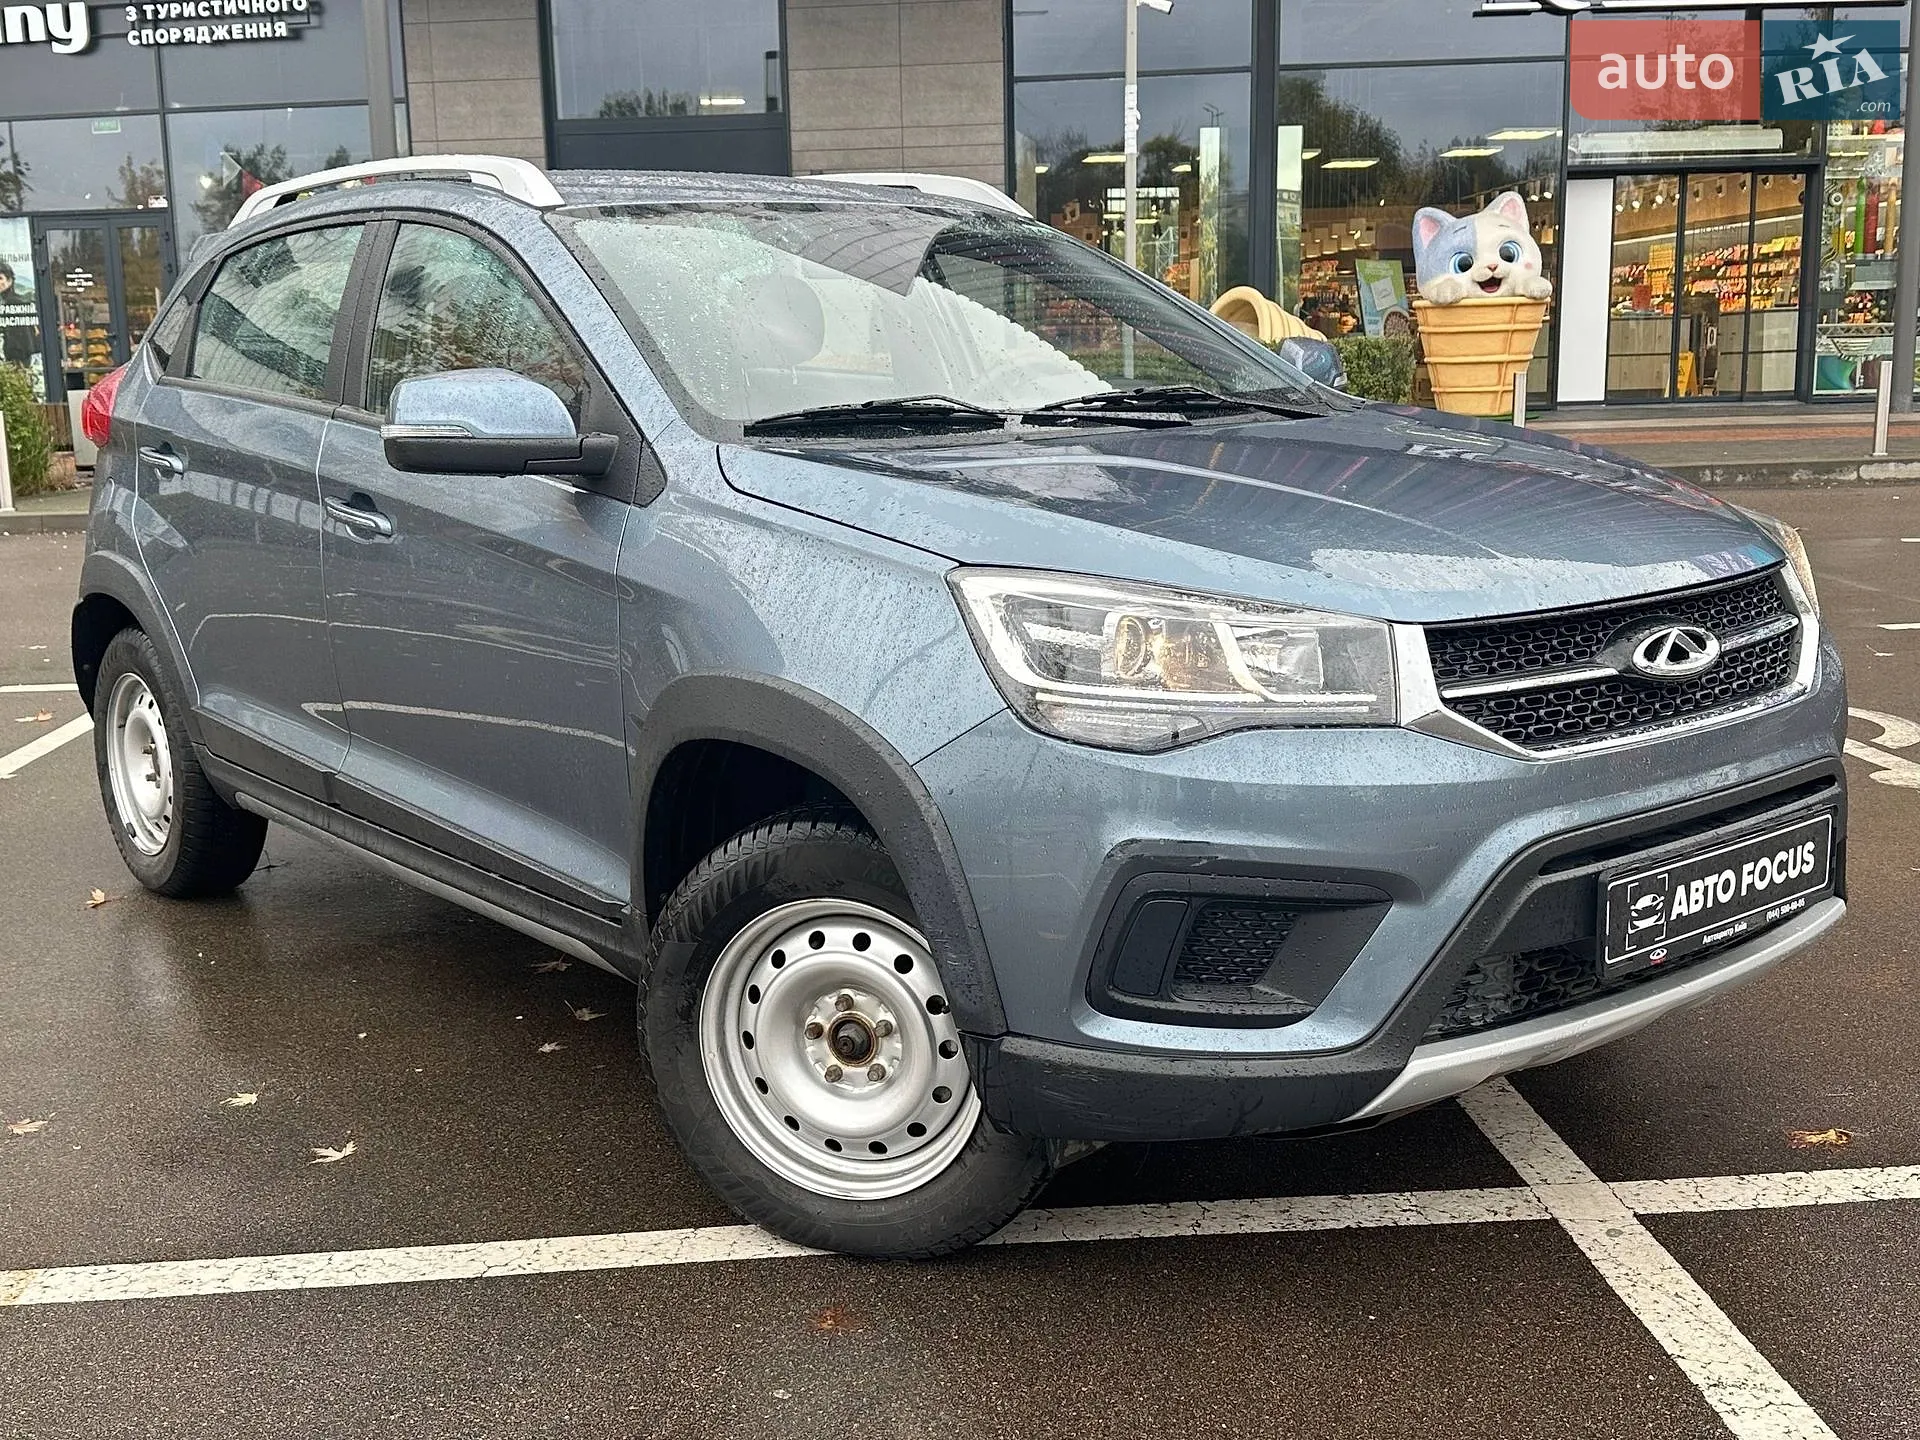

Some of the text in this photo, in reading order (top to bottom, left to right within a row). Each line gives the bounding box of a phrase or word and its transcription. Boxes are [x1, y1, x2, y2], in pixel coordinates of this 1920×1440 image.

[142, 0, 308, 20] ТУРИСТИЧНОГО
[0, 1, 88, 54] ny
[127, 21, 288, 46] СПОРЯДЖЕННЯ
[0, 303, 36, 315] РАВЖНІЙ
[1741, 841, 1816, 896] FOCUS
